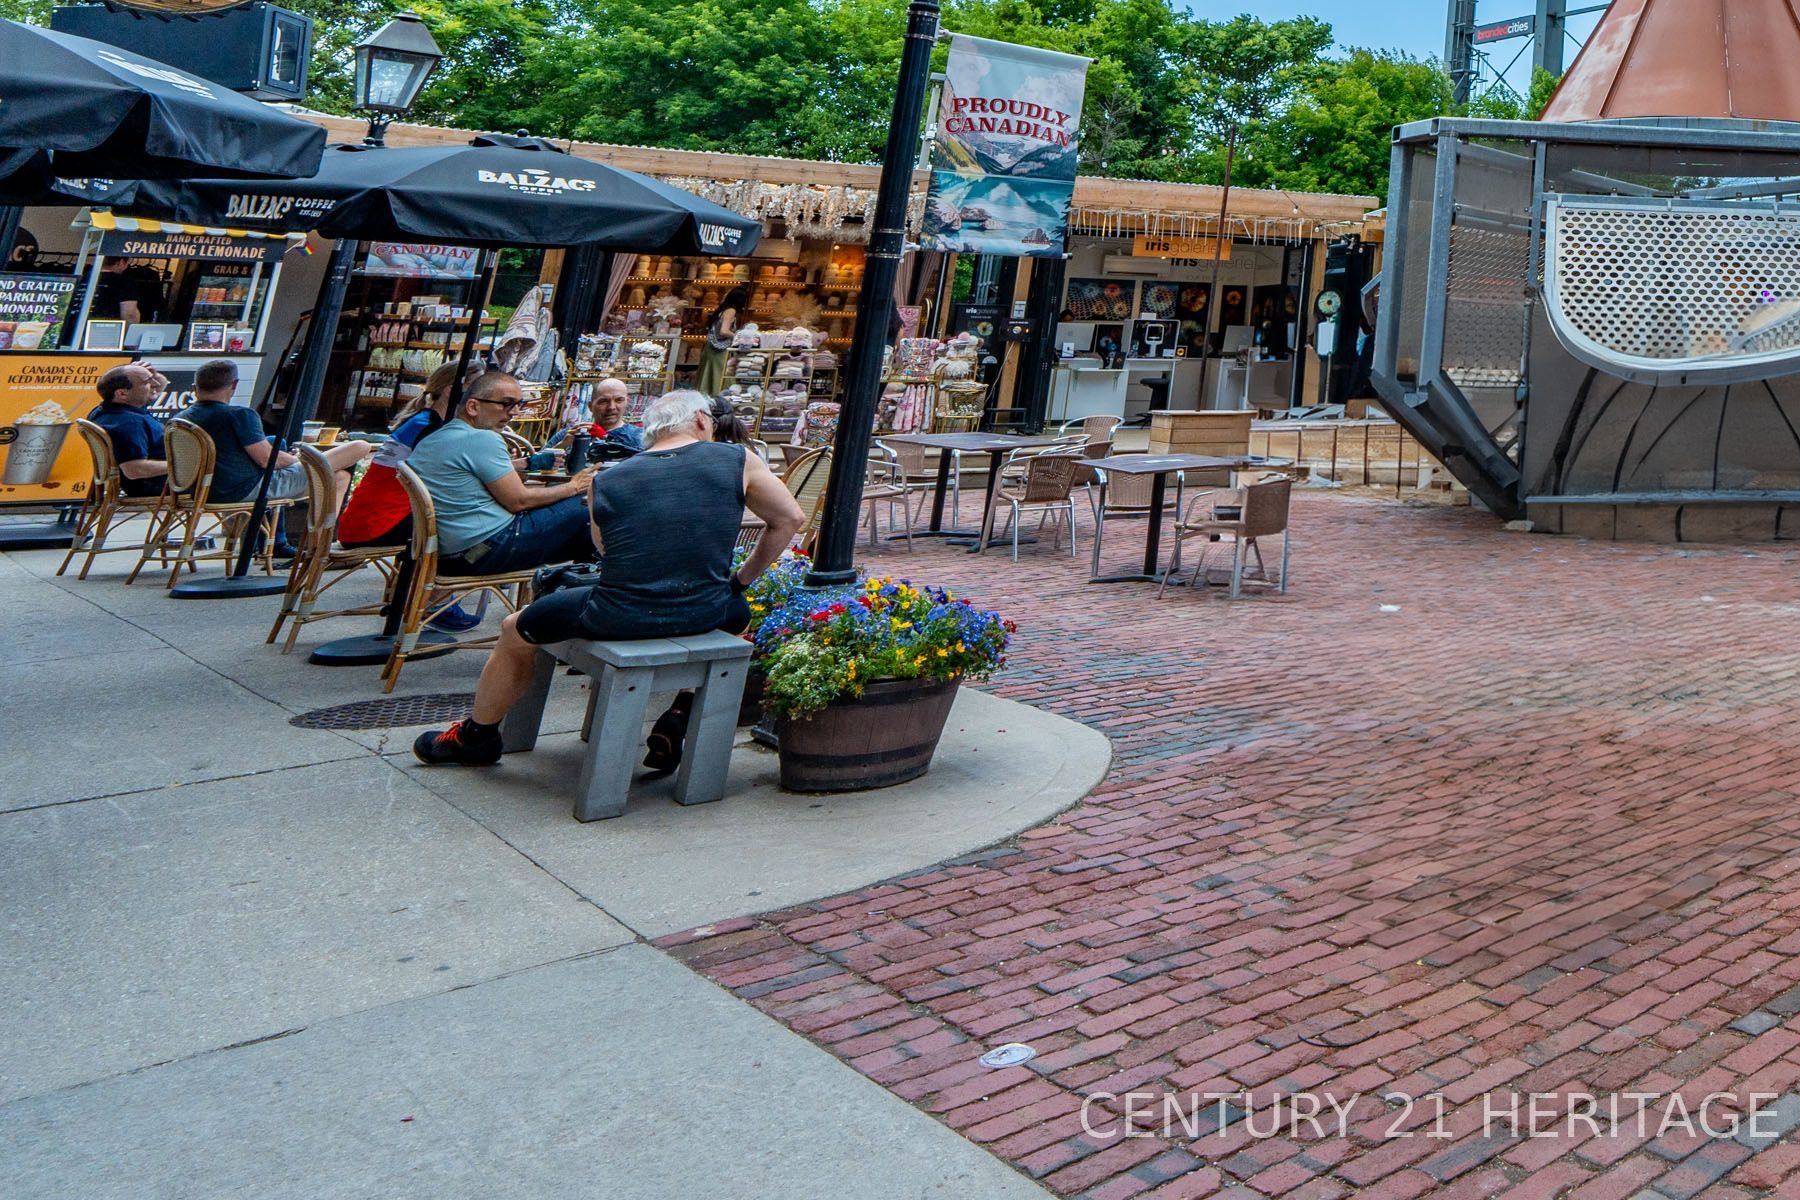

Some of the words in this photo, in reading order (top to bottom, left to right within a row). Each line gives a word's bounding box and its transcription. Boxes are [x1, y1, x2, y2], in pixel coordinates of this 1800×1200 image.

[952, 97, 1071, 128] PROUDLY
[945, 117, 1072, 148] CANADIAN
[509, 185, 563, 195] COFFEE
[295, 197, 336, 210] COFFEE
[165, 235, 191, 243] HAND
[193, 236, 232, 245] CRAFTED
[123, 242, 196, 256] SPARKLING
[200, 247, 266, 259] LEMONADE
[375, 244, 473, 258] CANADIAN
[213, 265, 239, 275] GRAB
[19, 280, 75, 292] CRAFTED
[22, 365, 74, 375] CANADA'S
[77, 367, 98, 375] CUP
[8, 375, 32, 384] ICED
[34, 376, 72, 384] MAPLE
[73, 376, 101, 384] LATT
